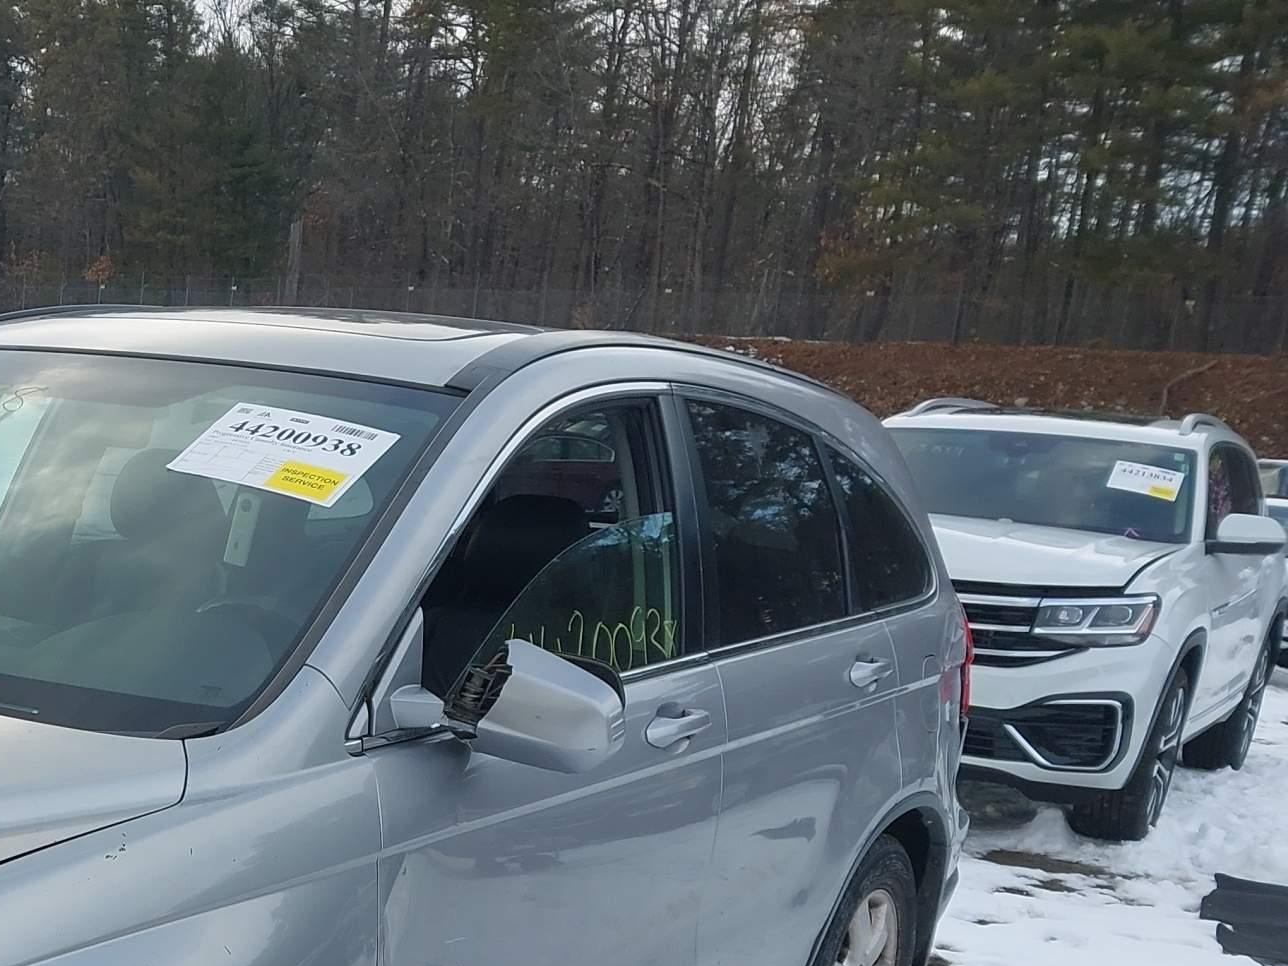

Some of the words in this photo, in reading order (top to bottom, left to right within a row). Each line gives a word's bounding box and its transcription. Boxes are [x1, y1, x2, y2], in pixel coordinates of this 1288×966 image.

[228, 420, 363, 458] 44200938
[281, 466, 340, 486] INSPECTION
[281, 475, 326, 491] SERVICE
